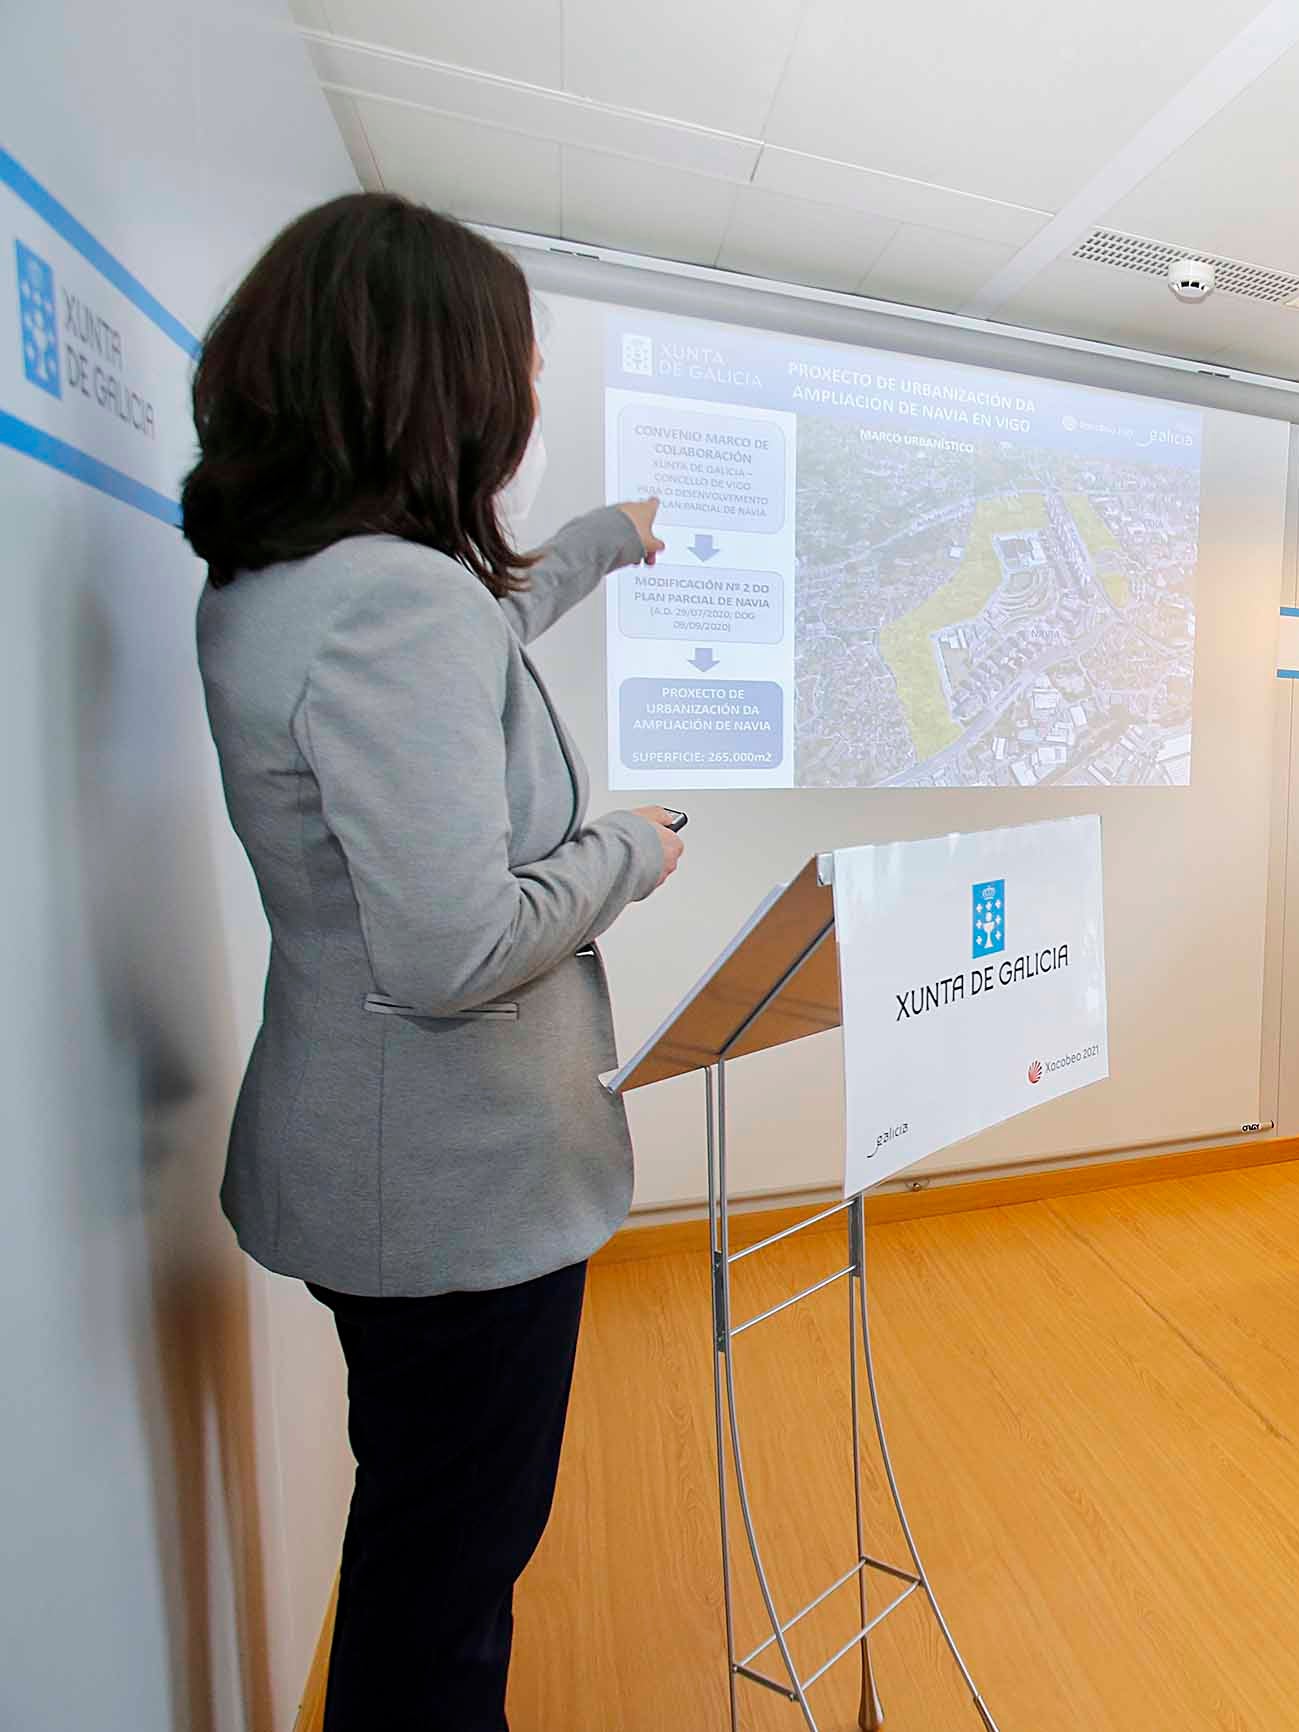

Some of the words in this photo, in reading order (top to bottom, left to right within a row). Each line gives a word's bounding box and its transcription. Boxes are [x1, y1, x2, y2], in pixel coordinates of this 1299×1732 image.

[63, 287, 122, 368] XUNTA
[661, 343, 726, 366] XUNTA
[659, 359, 681, 377] DE
[689, 365, 762, 388] GALICIA
[65, 343, 92, 400] DE
[94, 366, 155, 440] GALICIA
[788, 362, 872, 386] PROXECTO
[877, 377, 897, 392] DE
[1015, 398, 1036, 413] DA
[899, 400, 919, 416] DE
[922, 404, 969, 424] NAVIA
[973, 413, 992, 427] EN
[995, 415, 1031, 434] VIGO
[634, 424, 702, 442] CONVENIO
[705, 433, 751, 448] MARCO
[755, 439, 769, 450] DE
[860, 429, 902, 445] MARCO
[904, 432, 975, 454] URBANÍSTICO
[655, 444, 752, 464] COLABORACIÓN
[690, 463, 704, 473] DE
[706, 464, 745, 478] GALICIA
[654, 473, 709, 487] CONCELLO
[711, 479, 725, 488] DE
[726, 480, 751, 490] VIGO
[675, 488, 769, 505] DESENVOLVEMENTO
[686, 502, 721, 514] PARCIAL
[724, 505, 737, 515] DE
[738, 507, 768, 518] NAVIA
[635, 575, 723, 591] MODIFICACIÓN
[743, 584, 750, 593] 2
[753, 584, 770, 594] DO
[634, 592, 665, 602] PLAN
[668, 593, 715, 606] PARCIAL
[718, 596, 733, 606] DE
[736, 597, 771, 609] NAVIA
[662, 687, 726, 699] PROXECTO
[729, 689, 745, 699] DE
[646, 702, 740, 715] URBANIZACIÓN
[743, 705, 760, 716] DA
[633, 718, 712, 731] AMPLIACIÓN
[715, 720, 731, 730] DE
[734, 721, 772, 731] NAVIA
[632, 752, 705, 763] SUPERFICIE:
[896, 974, 965, 1021] XUNTA
[971, 965, 994, 996] DE
[999, 944, 1070, 986] GALICIA
[1045, 1052, 1081, 1073] Xacobeo
[1083, 1045, 1099, 1059] 2021
[866, 1123, 909, 1158] galicia
